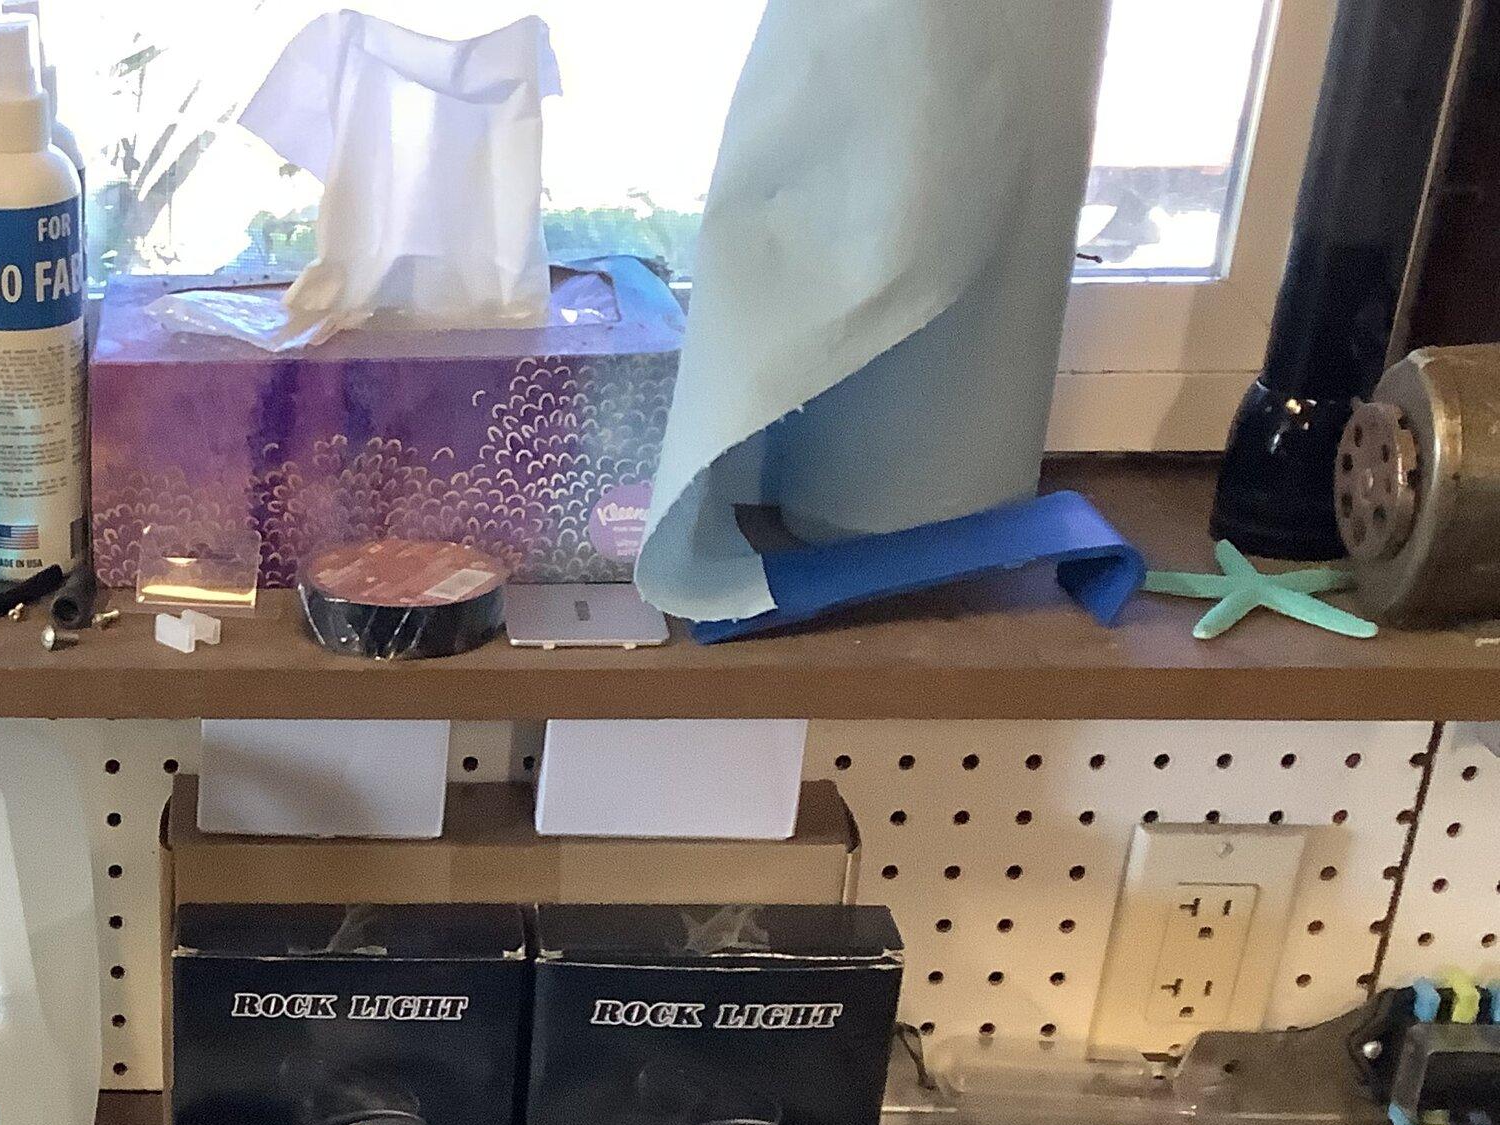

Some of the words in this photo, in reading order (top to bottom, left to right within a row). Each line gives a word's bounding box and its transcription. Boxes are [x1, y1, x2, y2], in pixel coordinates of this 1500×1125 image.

[37, 213, 71, 242] FOR
[596, 503, 650, 527] Kleen
[15, 559, 24, 568] IN
[26, 558, 43, 569] USA
[231, 993, 338, 1019] ROCK
[348, 995, 469, 1020] LIGHT
[590, 999, 706, 1028] ROCK
[713, 1003, 843, 1029] LIGHT
